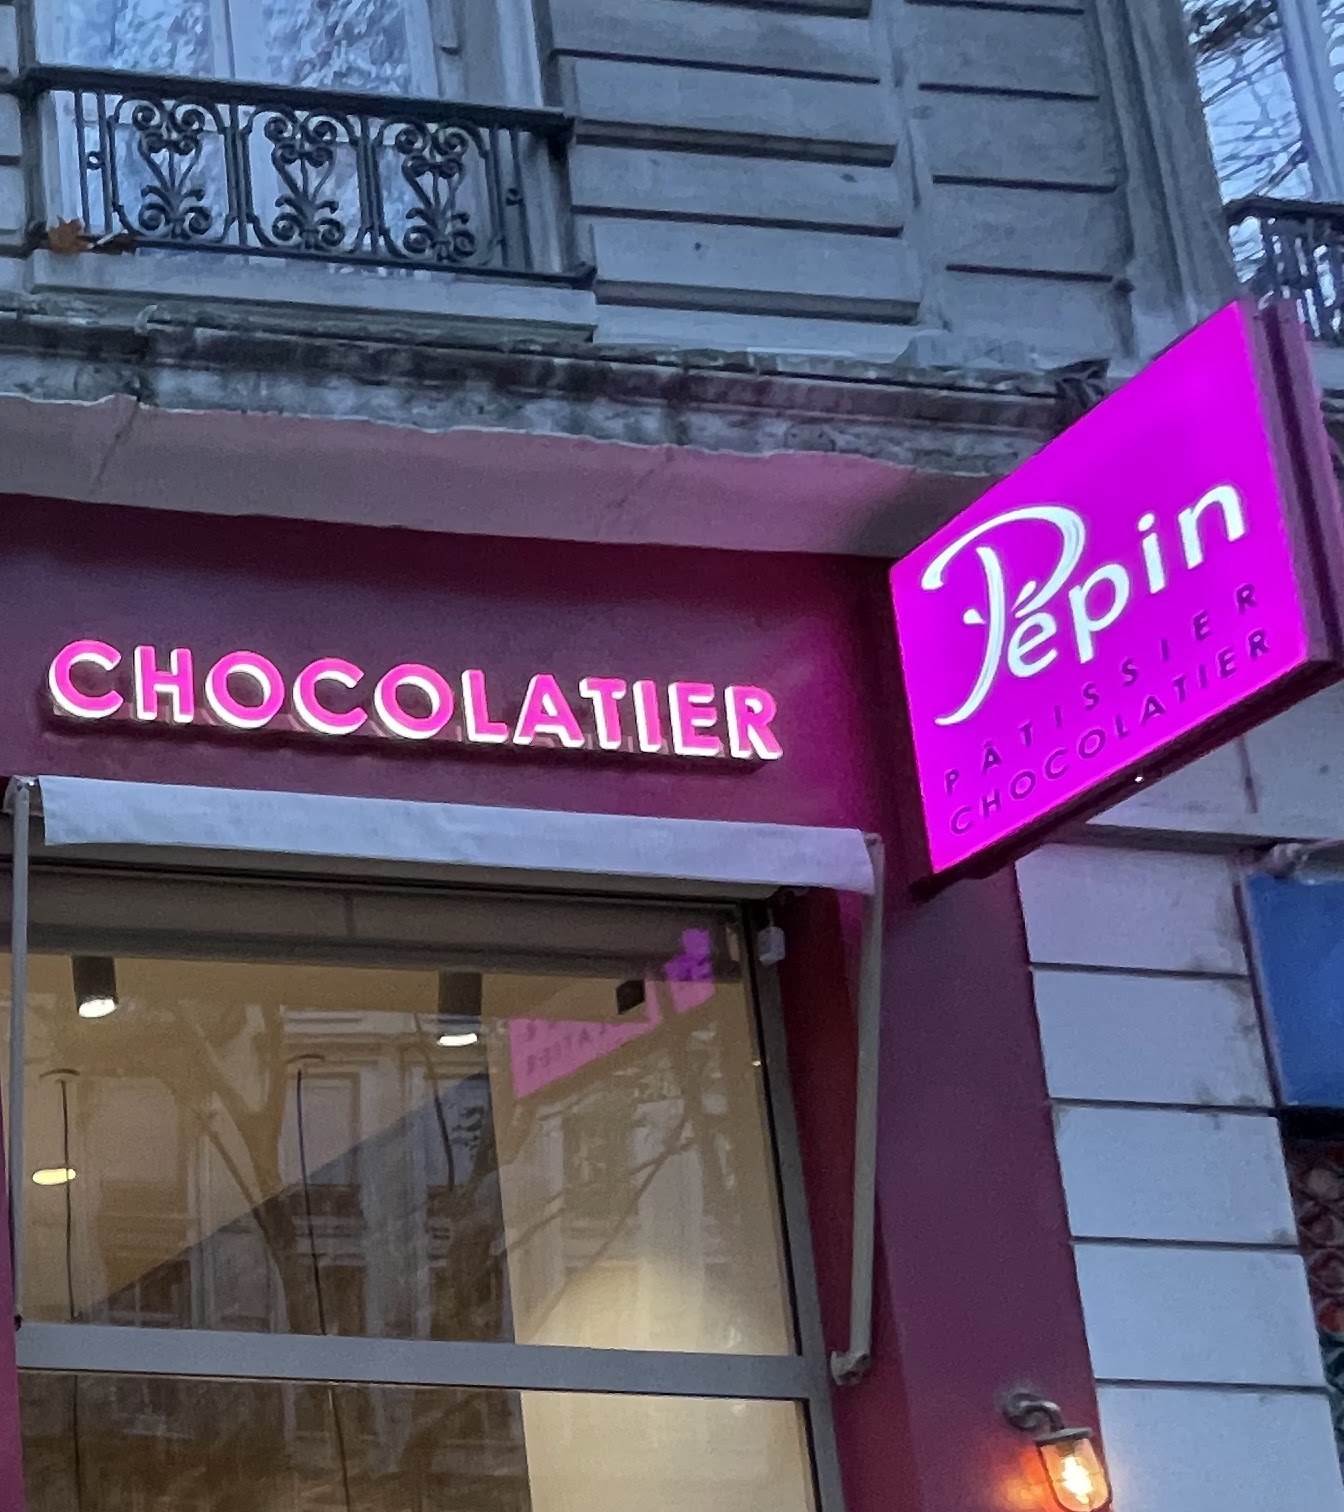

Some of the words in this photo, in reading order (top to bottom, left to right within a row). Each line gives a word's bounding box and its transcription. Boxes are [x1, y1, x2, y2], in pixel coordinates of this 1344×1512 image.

[49, 639, 783, 760] CHOCOLATIER
[944, 583, 1258, 796] PÂTISSIER
[950, 630, 1271, 835] CHOCOLATIER
